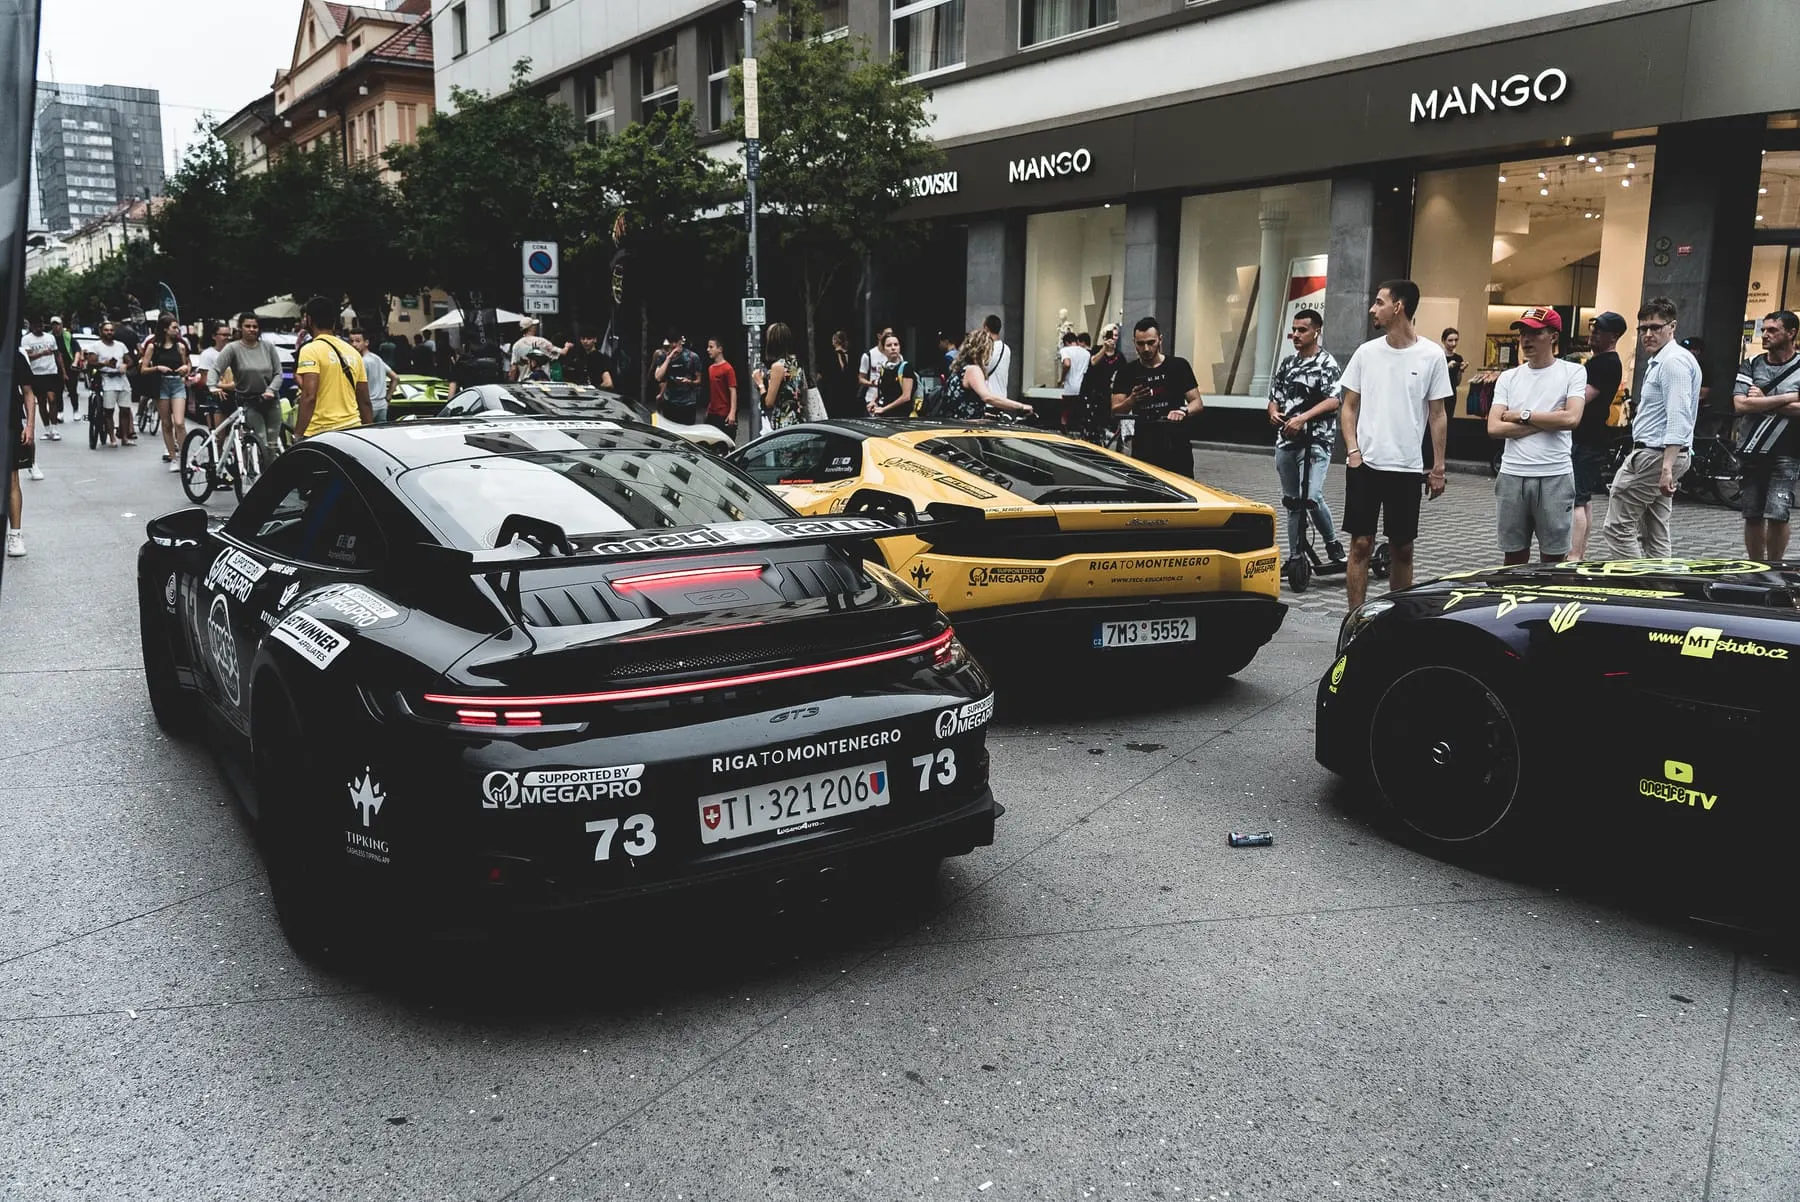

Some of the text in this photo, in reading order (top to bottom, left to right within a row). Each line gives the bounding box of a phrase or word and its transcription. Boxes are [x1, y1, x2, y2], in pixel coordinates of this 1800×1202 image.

[1410, 68, 1567, 122] MANGO
[1008, 148, 1091, 183] MANGO
[533, 301, 541, 309] 15
[216, 566, 254, 602] MEGAPRO
[988, 574, 1045, 583] MEGAPRO
[284, 614, 340, 653] BETWINNER
[1106, 619, 1190, 645] 7M3 5552
[298, 638, 327, 662] AFFILIATES
[769, 706, 820, 723] GT3
[538, 768, 630, 784] SUPPORTED BY
[912, 748, 957, 792] 73
[521, 779, 642, 804] MEGAPRO
[345, 831, 389, 853] TIPKING
[585, 813, 657, 862] 73
